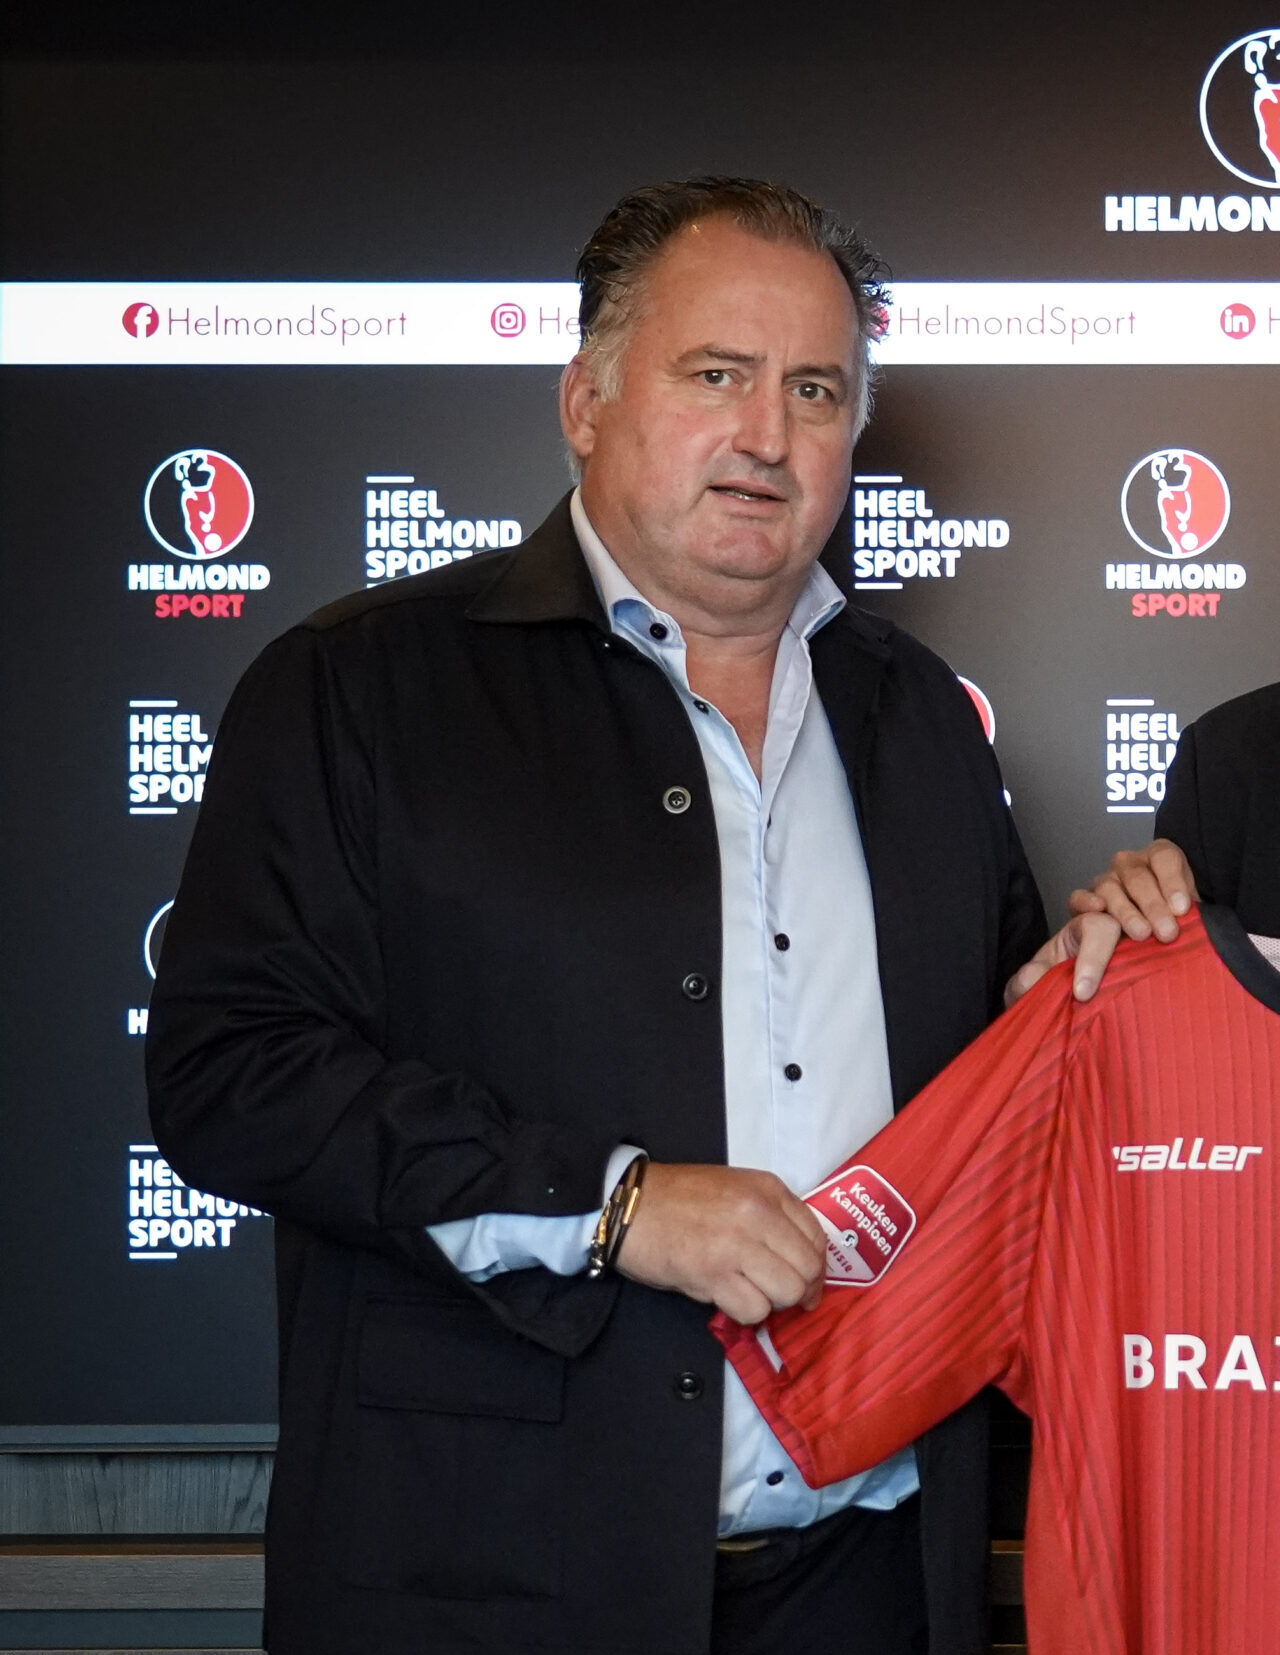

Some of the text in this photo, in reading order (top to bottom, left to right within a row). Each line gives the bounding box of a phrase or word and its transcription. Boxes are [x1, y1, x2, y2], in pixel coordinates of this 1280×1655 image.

[168, 305, 407, 346] HelmondSport
[899, 304, 1136, 345] HelmondSport
[366, 489, 446, 519] HEEL
[854, 489, 934, 518] HEEL
[366, 519, 522, 549] HELMOND
[854, 519, 1010, 548] HELMOND
[128, 564, 271, 591] HELMOND
[853, 549, 962, 578] SPORT
[1105, 563, 1247, 590] HELMOND
[155, 593, 246, 618] SPORT
[1131, 592, 1221, 618] SPORT
[129, 714, 209, 743] HEEL
[1106, 713, 1181, 741] HEEL
[129, 744, 214, 773] HELM
[1106, 772, 1167, 801] SPO
[129, 1159, 186, 1187] HE
[129, 1189, 274, 1217] HELMO
[849, 1182, 898, 1237] Keuken
[128, 1218, 236, 1247] SPORT
[829, 1186, 893, 1256] Kampioen
